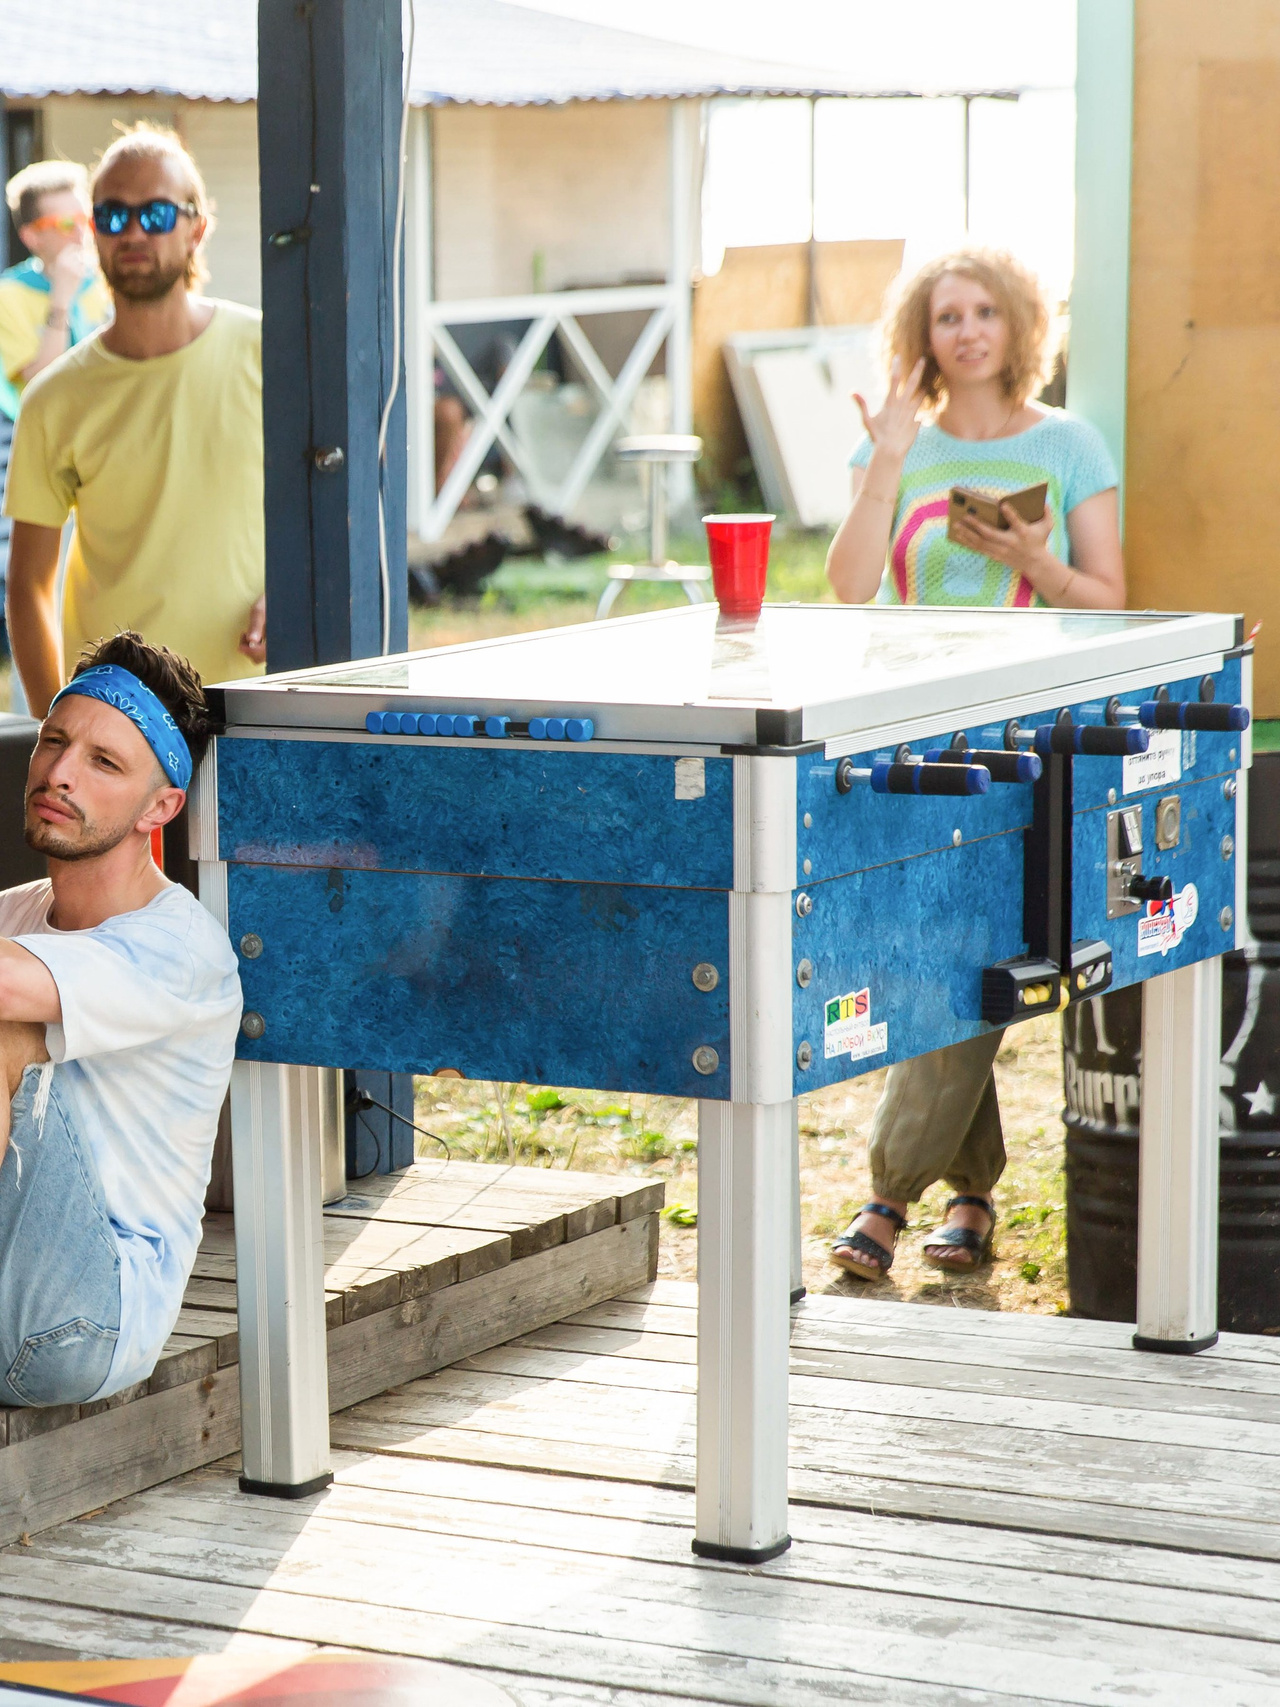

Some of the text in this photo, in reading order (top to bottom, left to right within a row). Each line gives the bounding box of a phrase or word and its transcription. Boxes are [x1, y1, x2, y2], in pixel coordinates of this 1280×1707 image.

[1146, 771, 1166, 785] упора
[826, 993, 869, 1025] RTS
[826, 1043, 835, 1054] НА
[837, 1032, 865, 1053] ЛЮБОЙ
